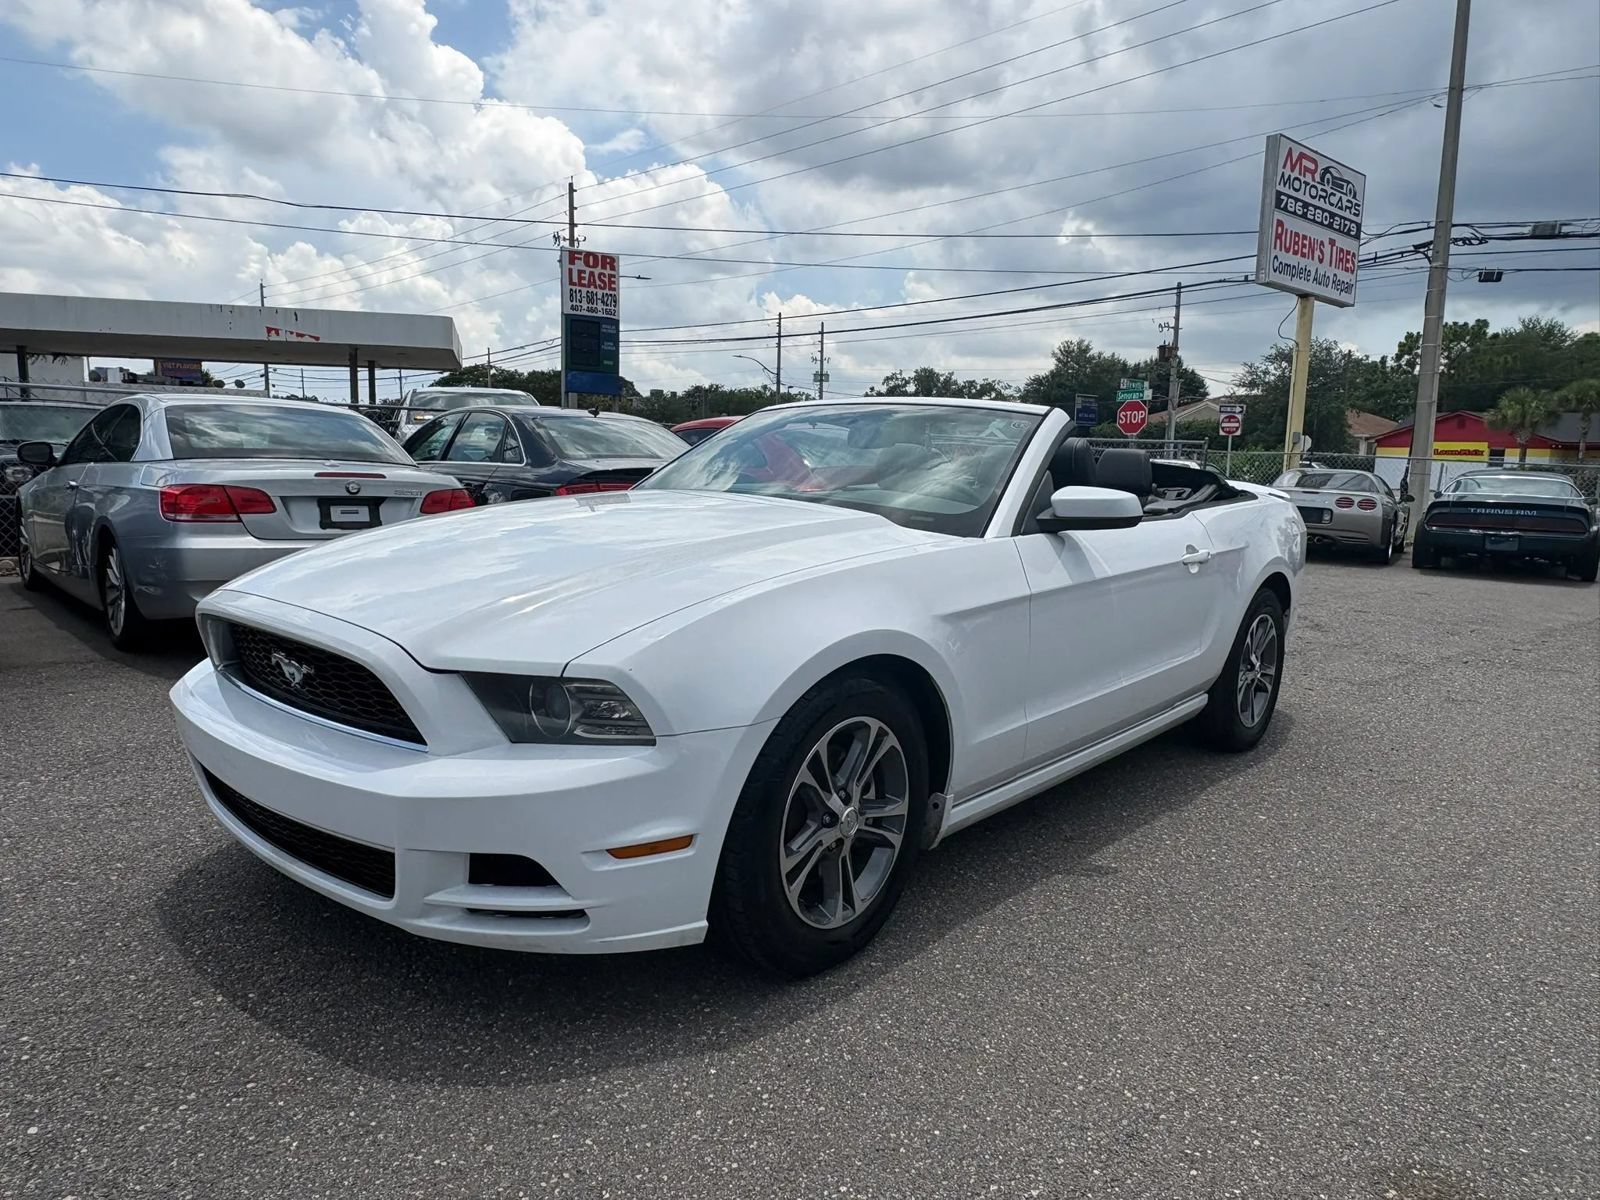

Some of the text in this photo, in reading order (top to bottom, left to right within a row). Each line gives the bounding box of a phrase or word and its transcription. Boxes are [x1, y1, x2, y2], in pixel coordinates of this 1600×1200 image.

[1282, 146, 1319, 183] MR
[1278, 171, 1362, 218] MOTORCARS
[567, 250, 617, 271] FOR
[1273, 217, 1357, 275] RUBEN'S TIRES
[567, 267, 617, 292] LEASE
[1271, 254, 1355, 296] Complete Auto Repair
[569, 287, 617, 308] 813-681-4279
[1119, 411, 1145, 424] STOP
